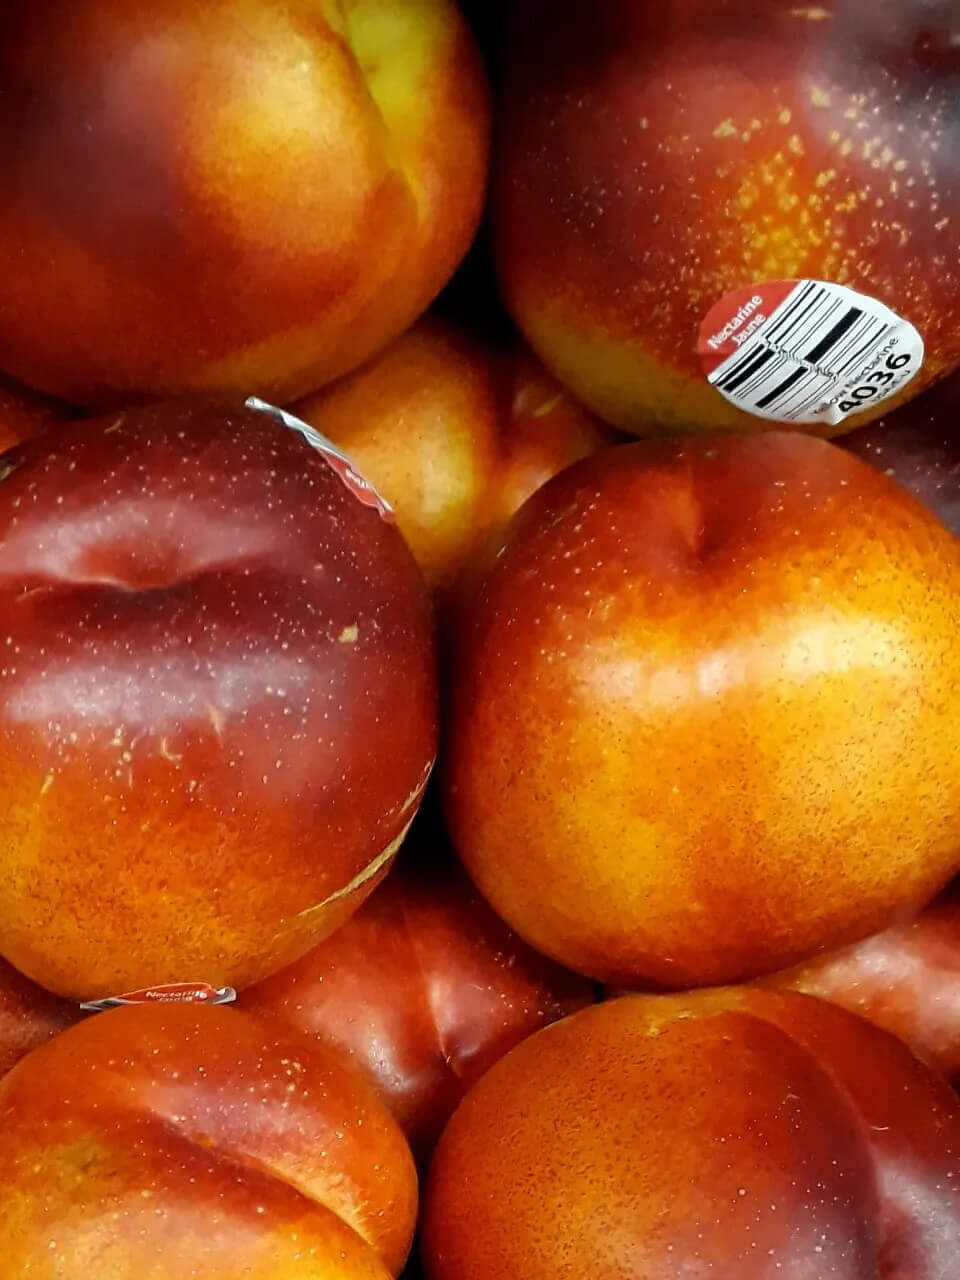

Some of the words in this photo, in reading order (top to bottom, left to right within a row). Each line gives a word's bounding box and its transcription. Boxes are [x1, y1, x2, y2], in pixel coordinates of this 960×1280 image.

[707, 295, 763, 349] Nectarine
[731, 313, 767, 347] Jaune
[837, 353, 912, 413] 4036
